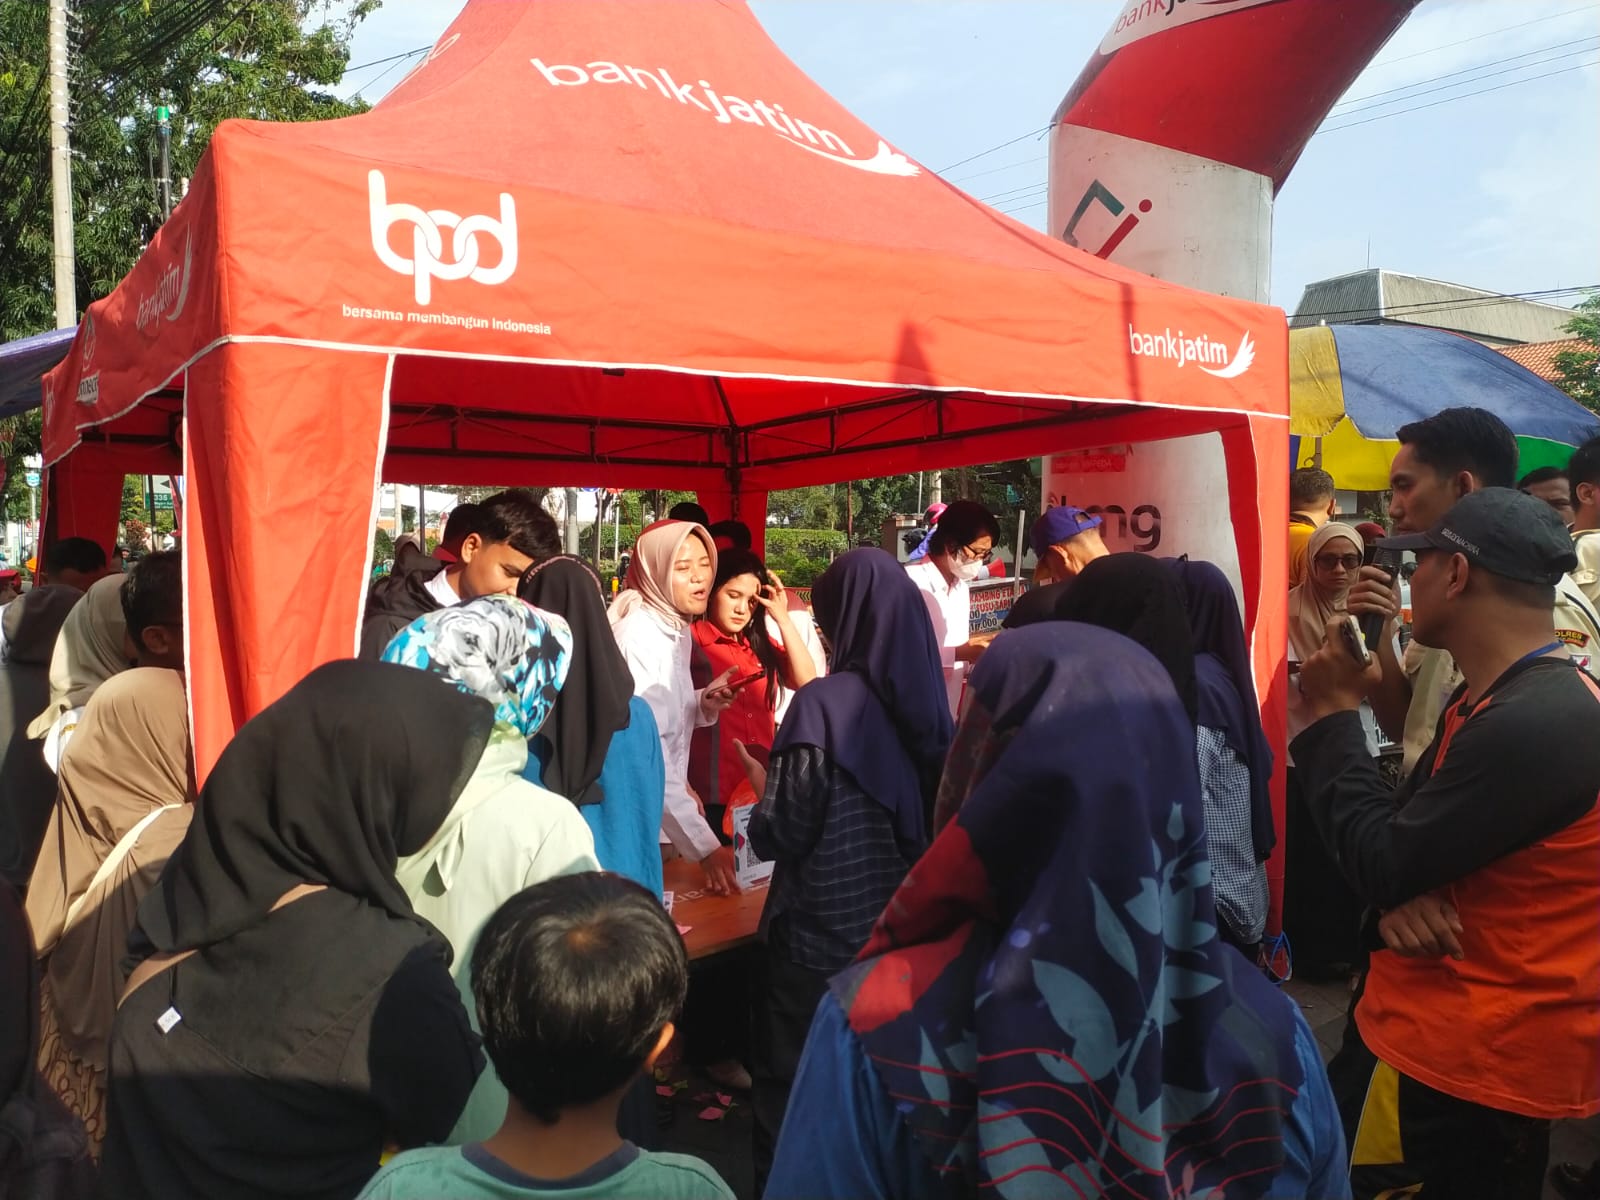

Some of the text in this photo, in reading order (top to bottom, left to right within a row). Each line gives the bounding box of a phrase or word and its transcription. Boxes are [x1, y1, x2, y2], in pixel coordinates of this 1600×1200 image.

[530, 58, 856, 156] bankjatim
[367, 168, 519, 306] bpd
[342, 303, 404, 322] bersama
[407, 311, 489, 329] membangun
[1128, 322, 1229, 368] bankjatim
